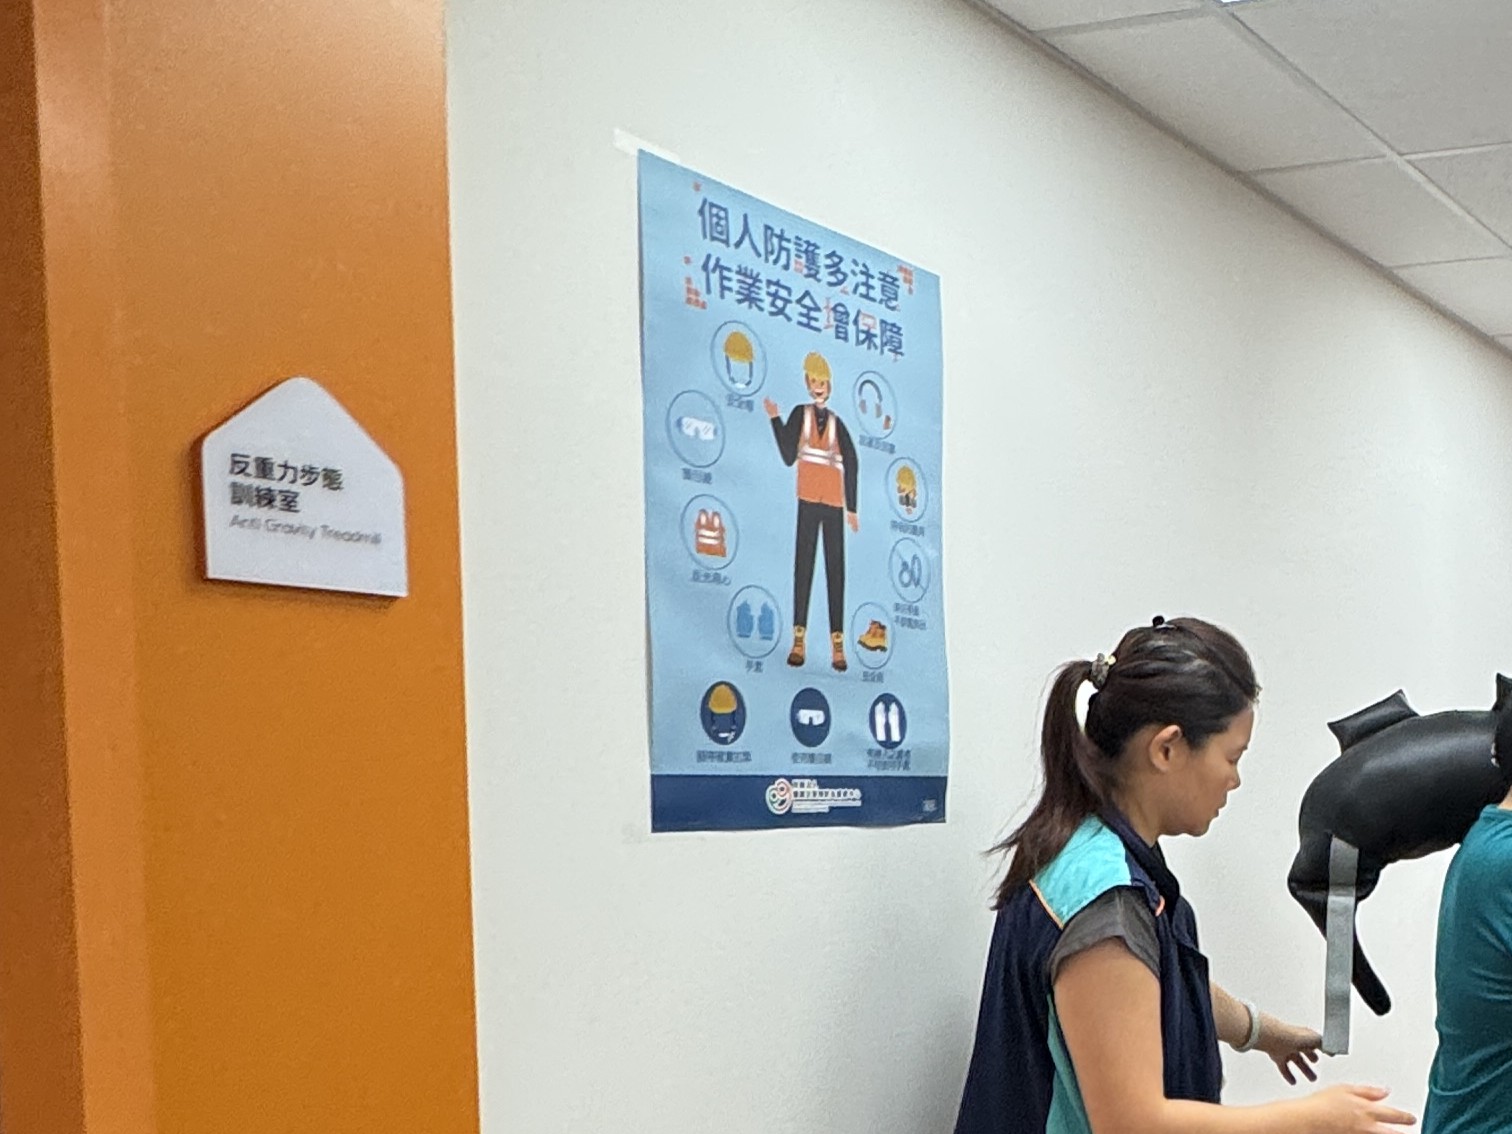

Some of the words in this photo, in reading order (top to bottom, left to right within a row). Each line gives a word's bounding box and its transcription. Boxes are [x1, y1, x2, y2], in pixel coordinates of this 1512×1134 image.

[698, 198, 901, 312] 個人防護多注意
[701, 252, 905, 358] 作業安全增保障
[229, 453, 344, 491] 反重力步態
[229, 481, 300, 513] 訓練室
